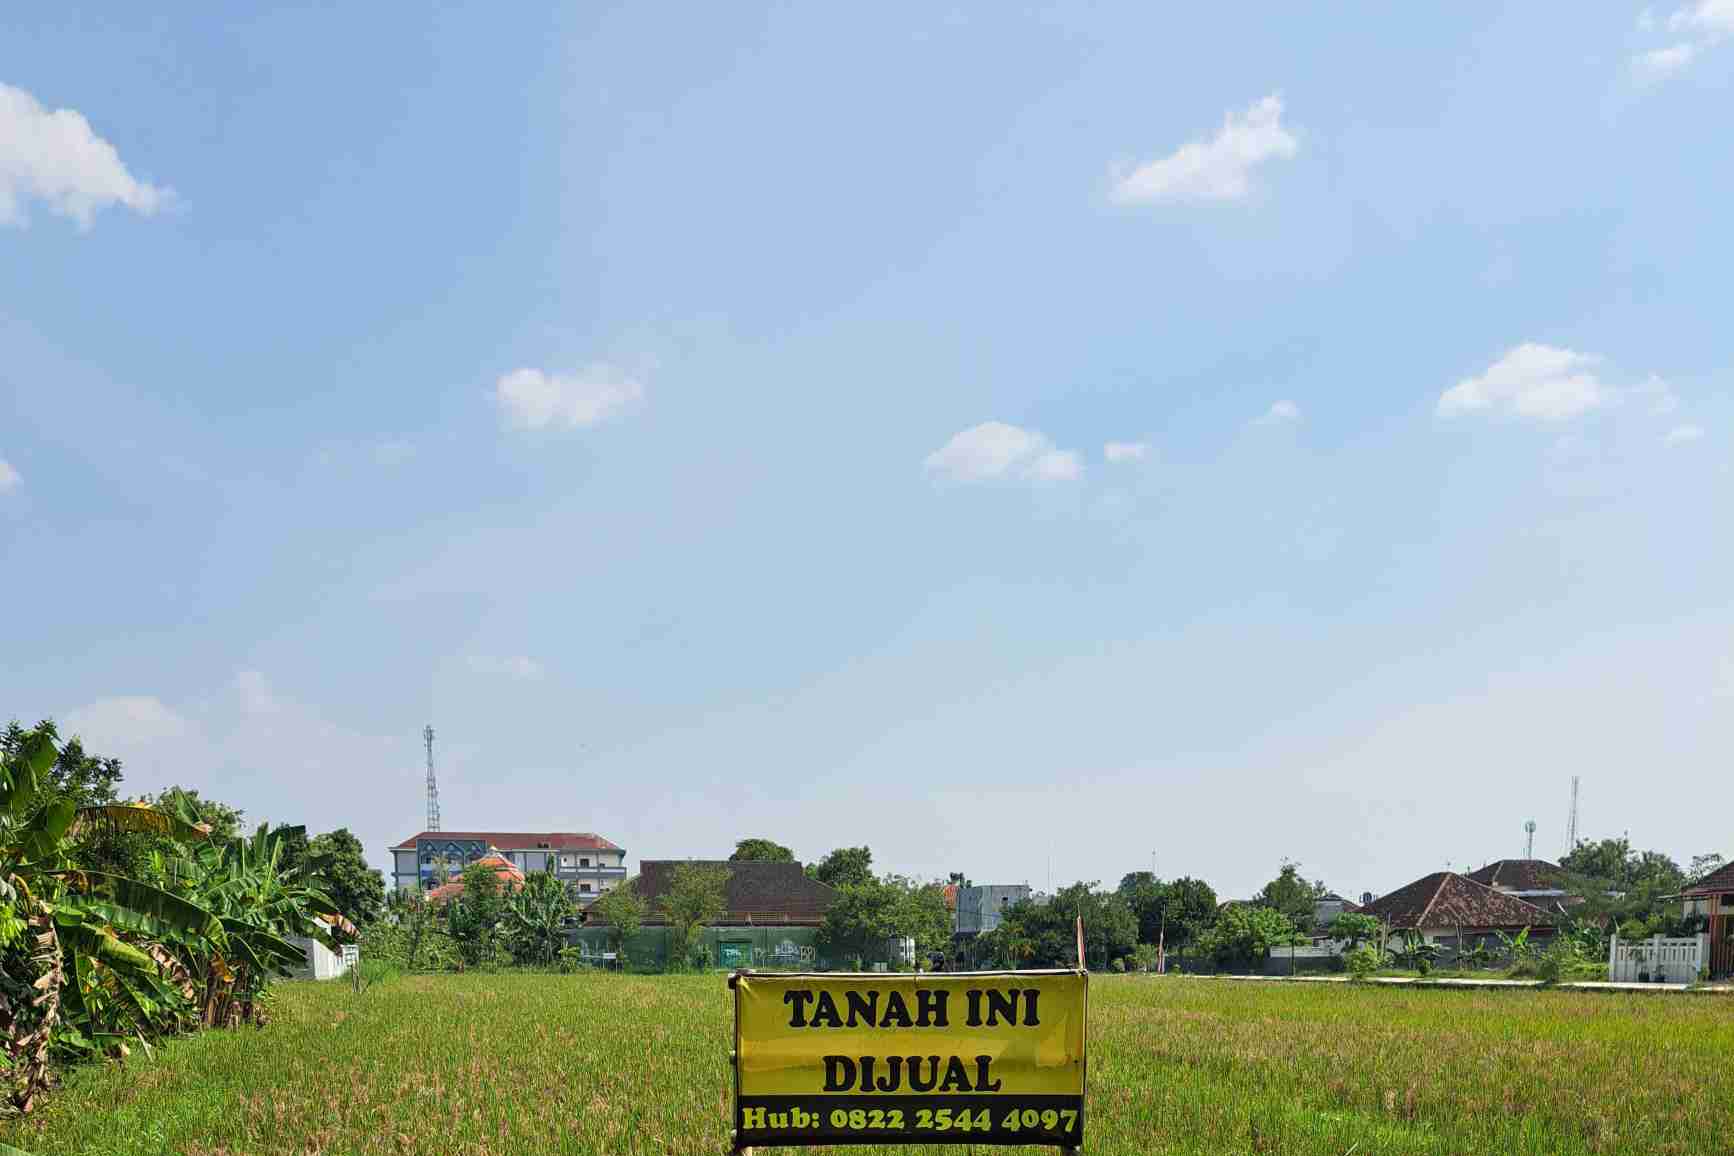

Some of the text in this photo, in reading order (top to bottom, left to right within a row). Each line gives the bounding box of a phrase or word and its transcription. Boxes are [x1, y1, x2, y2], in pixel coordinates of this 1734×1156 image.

[783, 989, 1041, 1028] TANAH INI
[822, 1055, 1001, 1092] DIJUAL
[742, 1107, 1078, 1133] Hub: 0822 2544 4097
